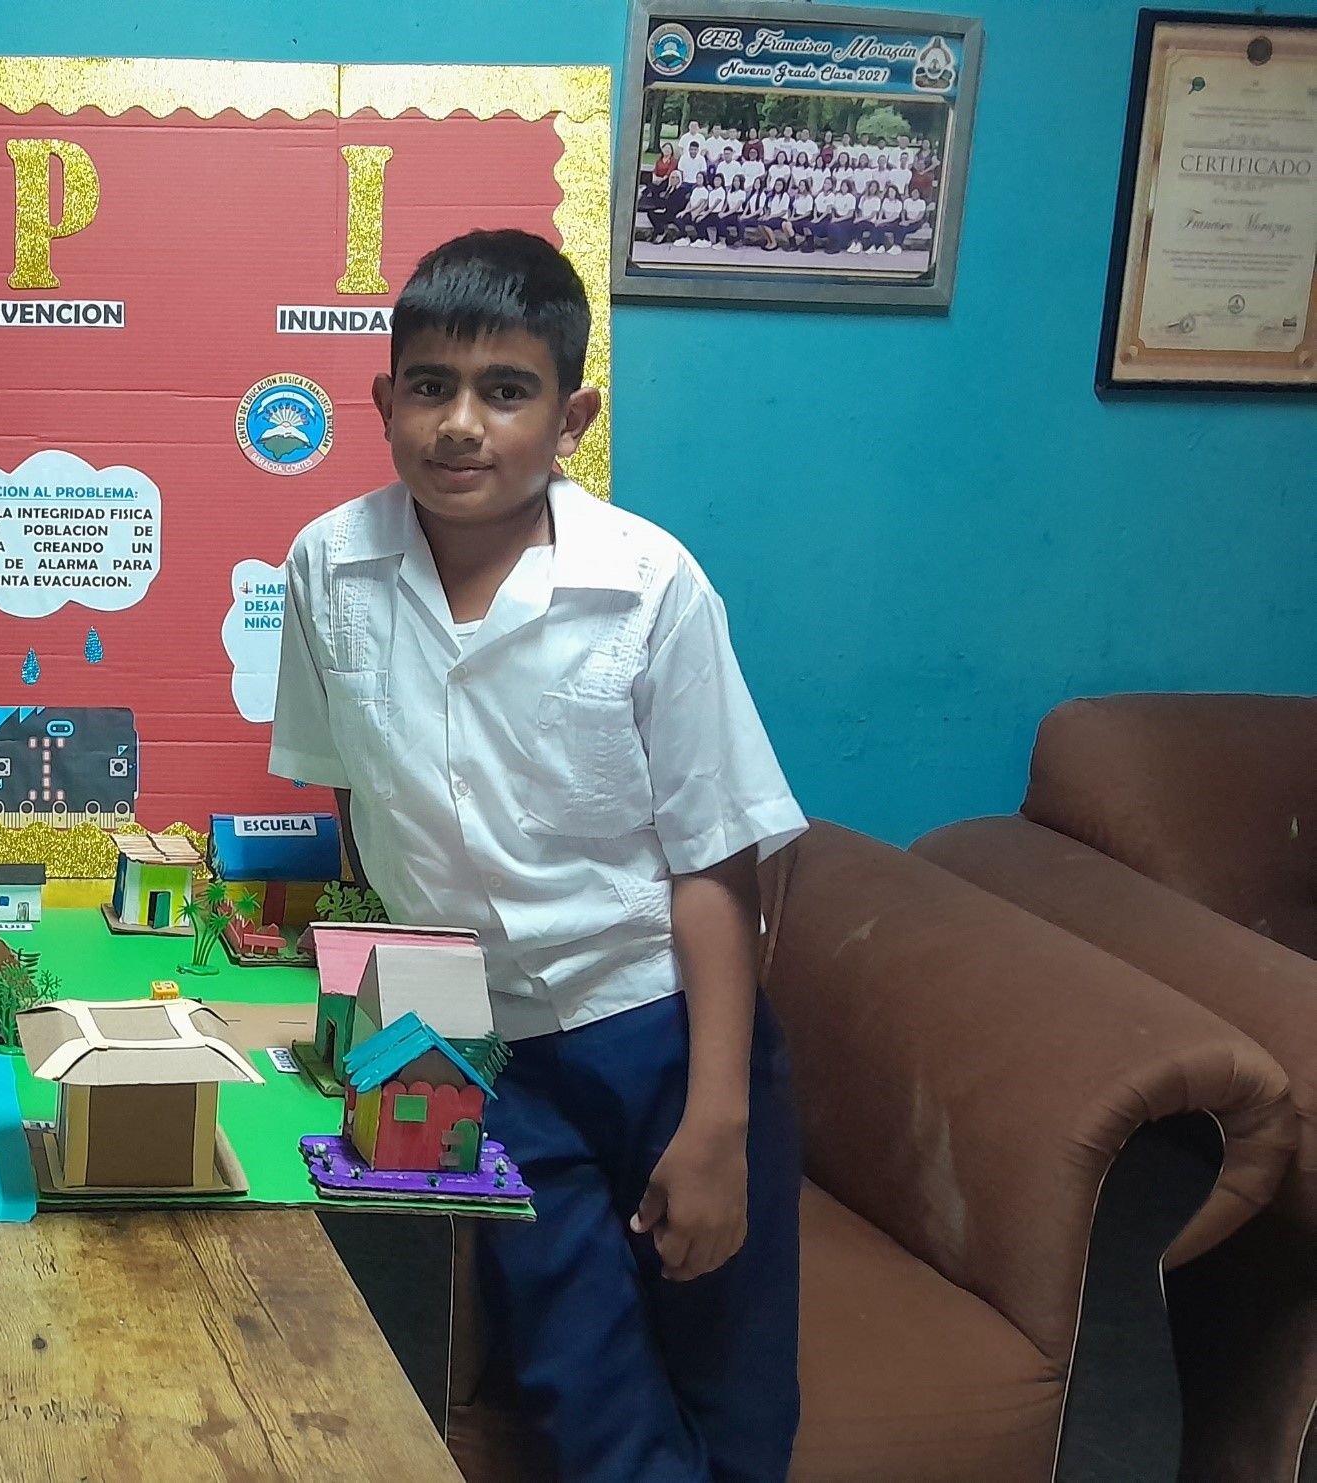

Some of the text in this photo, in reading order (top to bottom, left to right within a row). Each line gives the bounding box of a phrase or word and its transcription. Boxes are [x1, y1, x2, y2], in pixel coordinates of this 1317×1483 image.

[747, 31, 831, 58] Francisco
[720, 61, 888, 82] Noveno Grado Clase 2021
[1180, 154, 1312, 176] CERTIFICADO
[6, 138, 100, 289] P
[336, 145, 394, 294] I
[279, 376, 303, 385] BASICA
[244, 378, 277, 407] EDUCACION
[304, 381, 332, 413] FRANCISCO
[240, 407, 247, 415] DE
[238, 417, 247, 444] CENTRO
[286, 459, 313, 472] CORTES
[33, 487, 52, 498] AL
[56, 487, 138, 499] PROBLEMA:
[17, 508, 105, 520] INTEGRIDAD
[110, 508, 153, 520] FISICA
[24, 525, 109, 537] POBLACION
[134, 525, 153, 537] DE
[34, 541, 104, 553] CREANDO
[132, 542, 153, 554] UN
[5, 558, 23, 570] DE
[38, 559, 99, 570] ALARMA
[113, 559, 153, 571] PARA
[33, 575, 132, 588] EVACUACION.
[243, 818, 312, 833] ESCUELA
